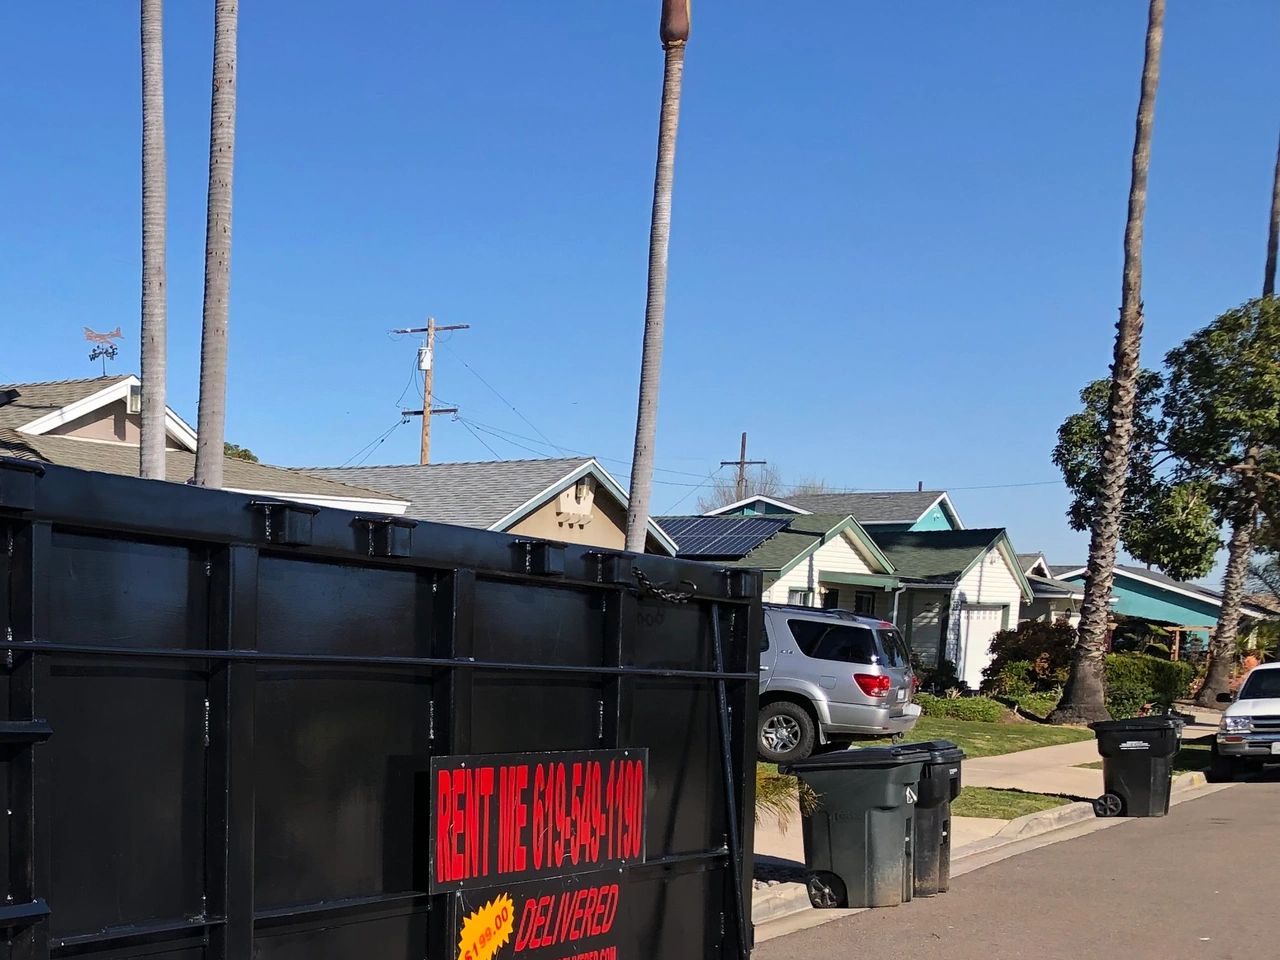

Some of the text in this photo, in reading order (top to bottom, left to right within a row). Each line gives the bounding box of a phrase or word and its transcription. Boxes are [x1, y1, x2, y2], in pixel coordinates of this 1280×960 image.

[437, 760, 643, 882] RENT ME 619-549-1190
[514, 884, 619, 951] DELIVERED
